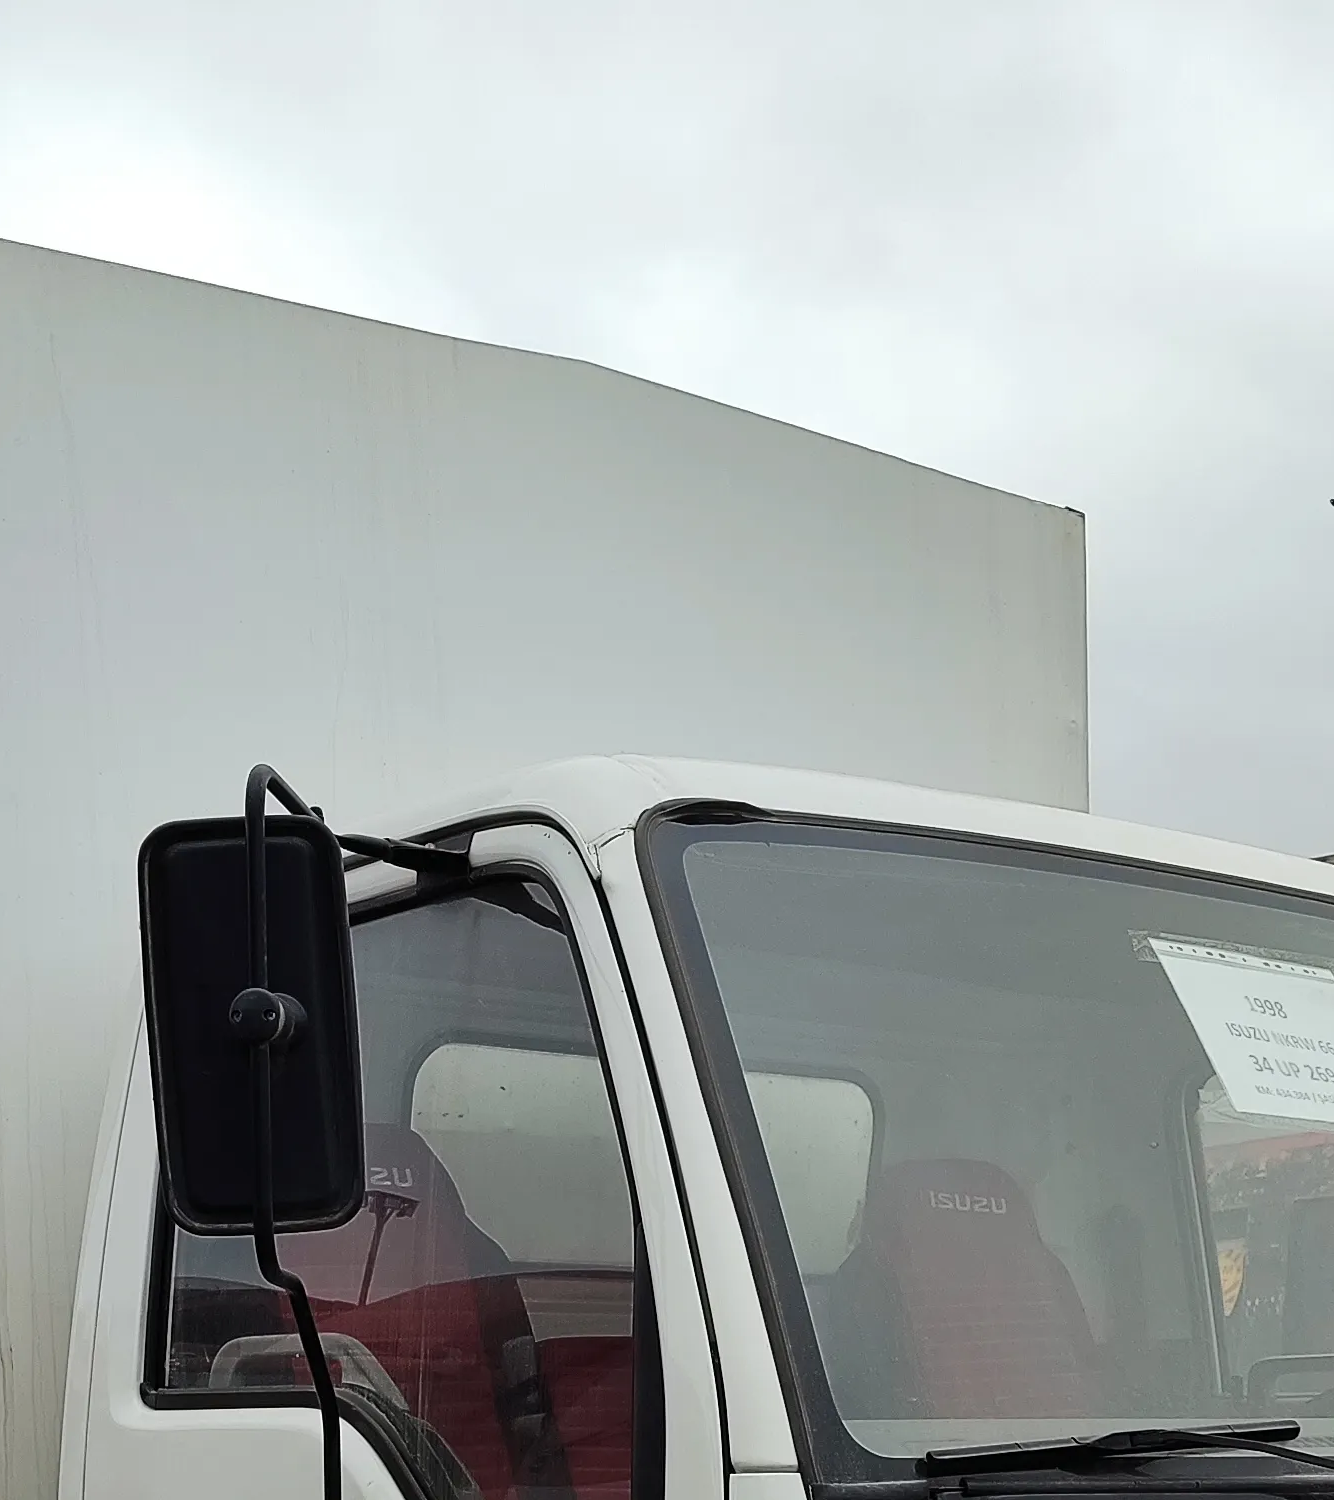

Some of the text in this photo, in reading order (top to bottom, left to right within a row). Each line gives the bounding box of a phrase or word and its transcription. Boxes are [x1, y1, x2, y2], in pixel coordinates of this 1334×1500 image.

[1244, 995, 1288, 1019] 1998
[1225, 1022, 1271, 1043] ISUZU
[1248, 1054, 1275, 1075] 34
[1274, 1058, 1301, 1079] UP
[370, 1166, 413, 1187] ZU
[928, 1190, 1007, 1215] ISUZU
